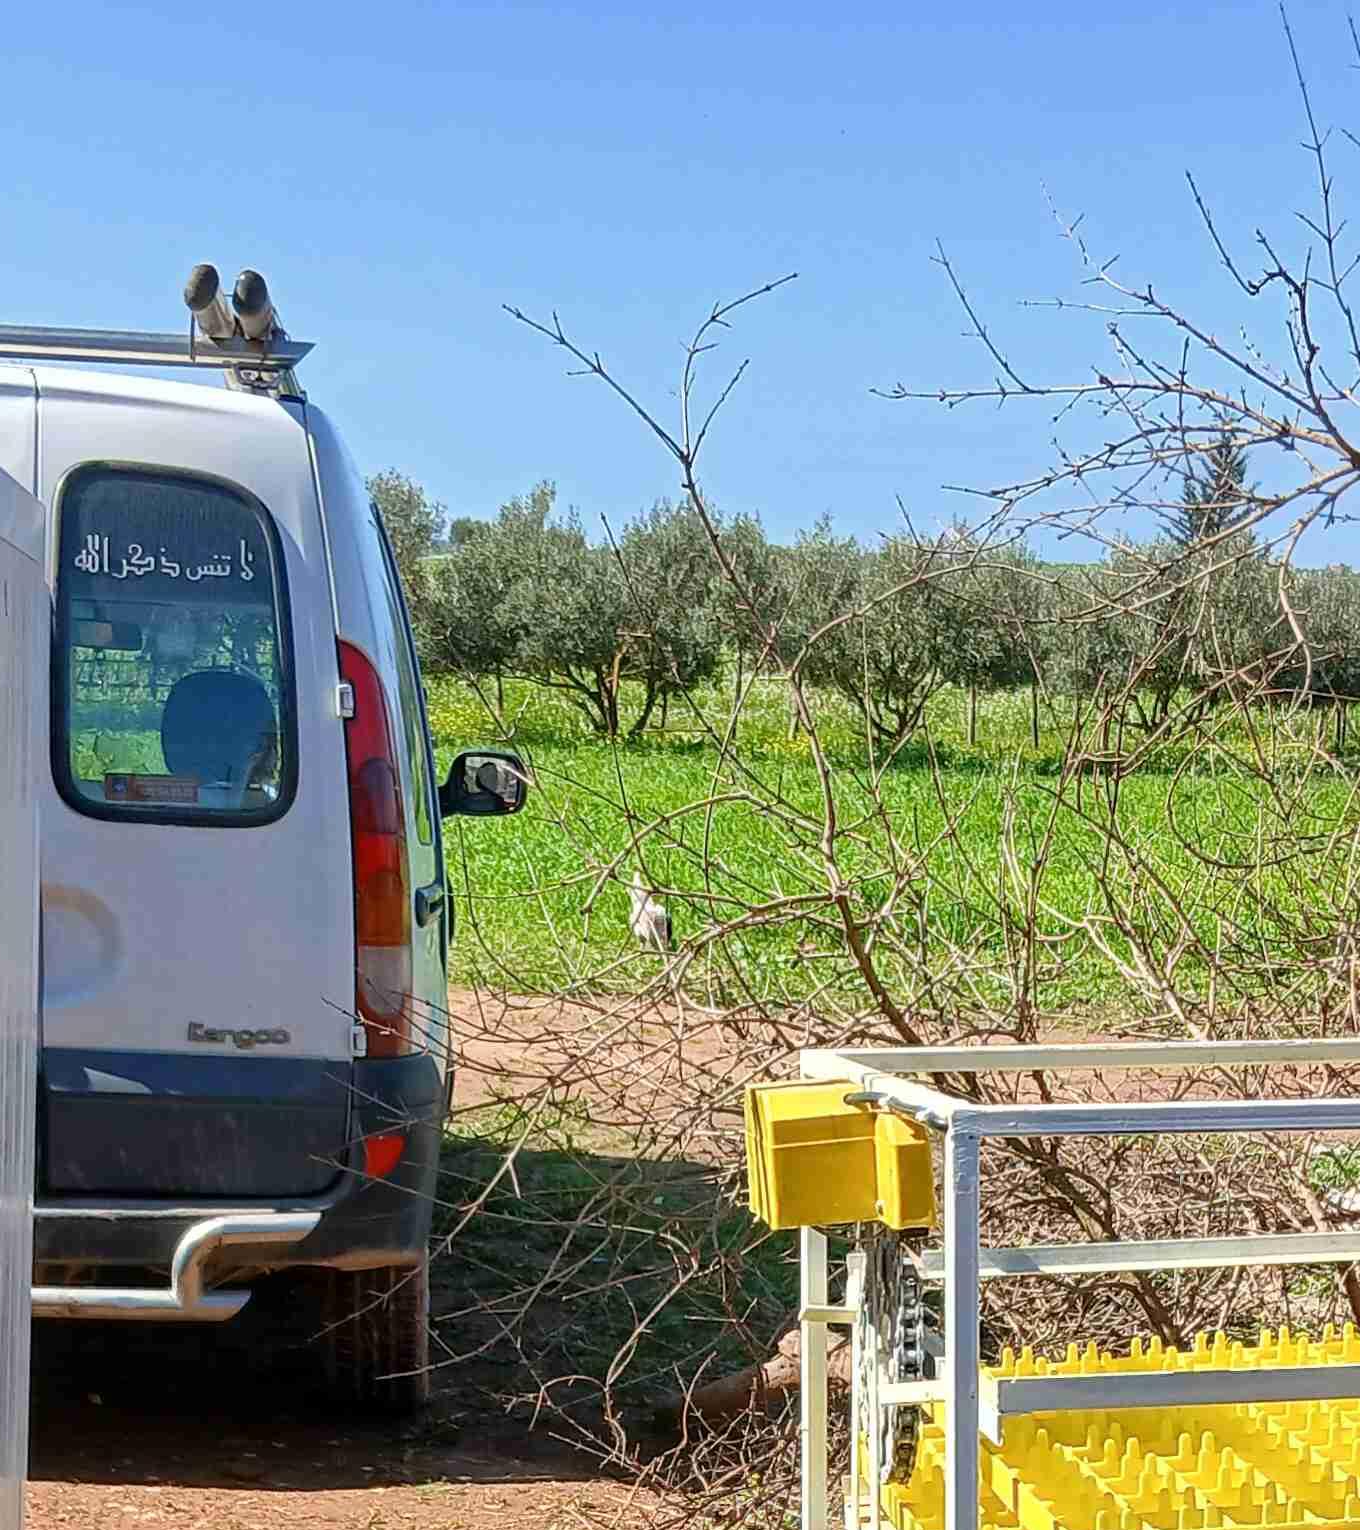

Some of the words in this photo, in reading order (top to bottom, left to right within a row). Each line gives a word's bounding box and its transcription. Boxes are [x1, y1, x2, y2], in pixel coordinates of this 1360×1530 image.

[74, 533, 110, 575] الله
[111, 543, 181, 579] ذكر
[187, 1020, 291, 1050] Kangoo
